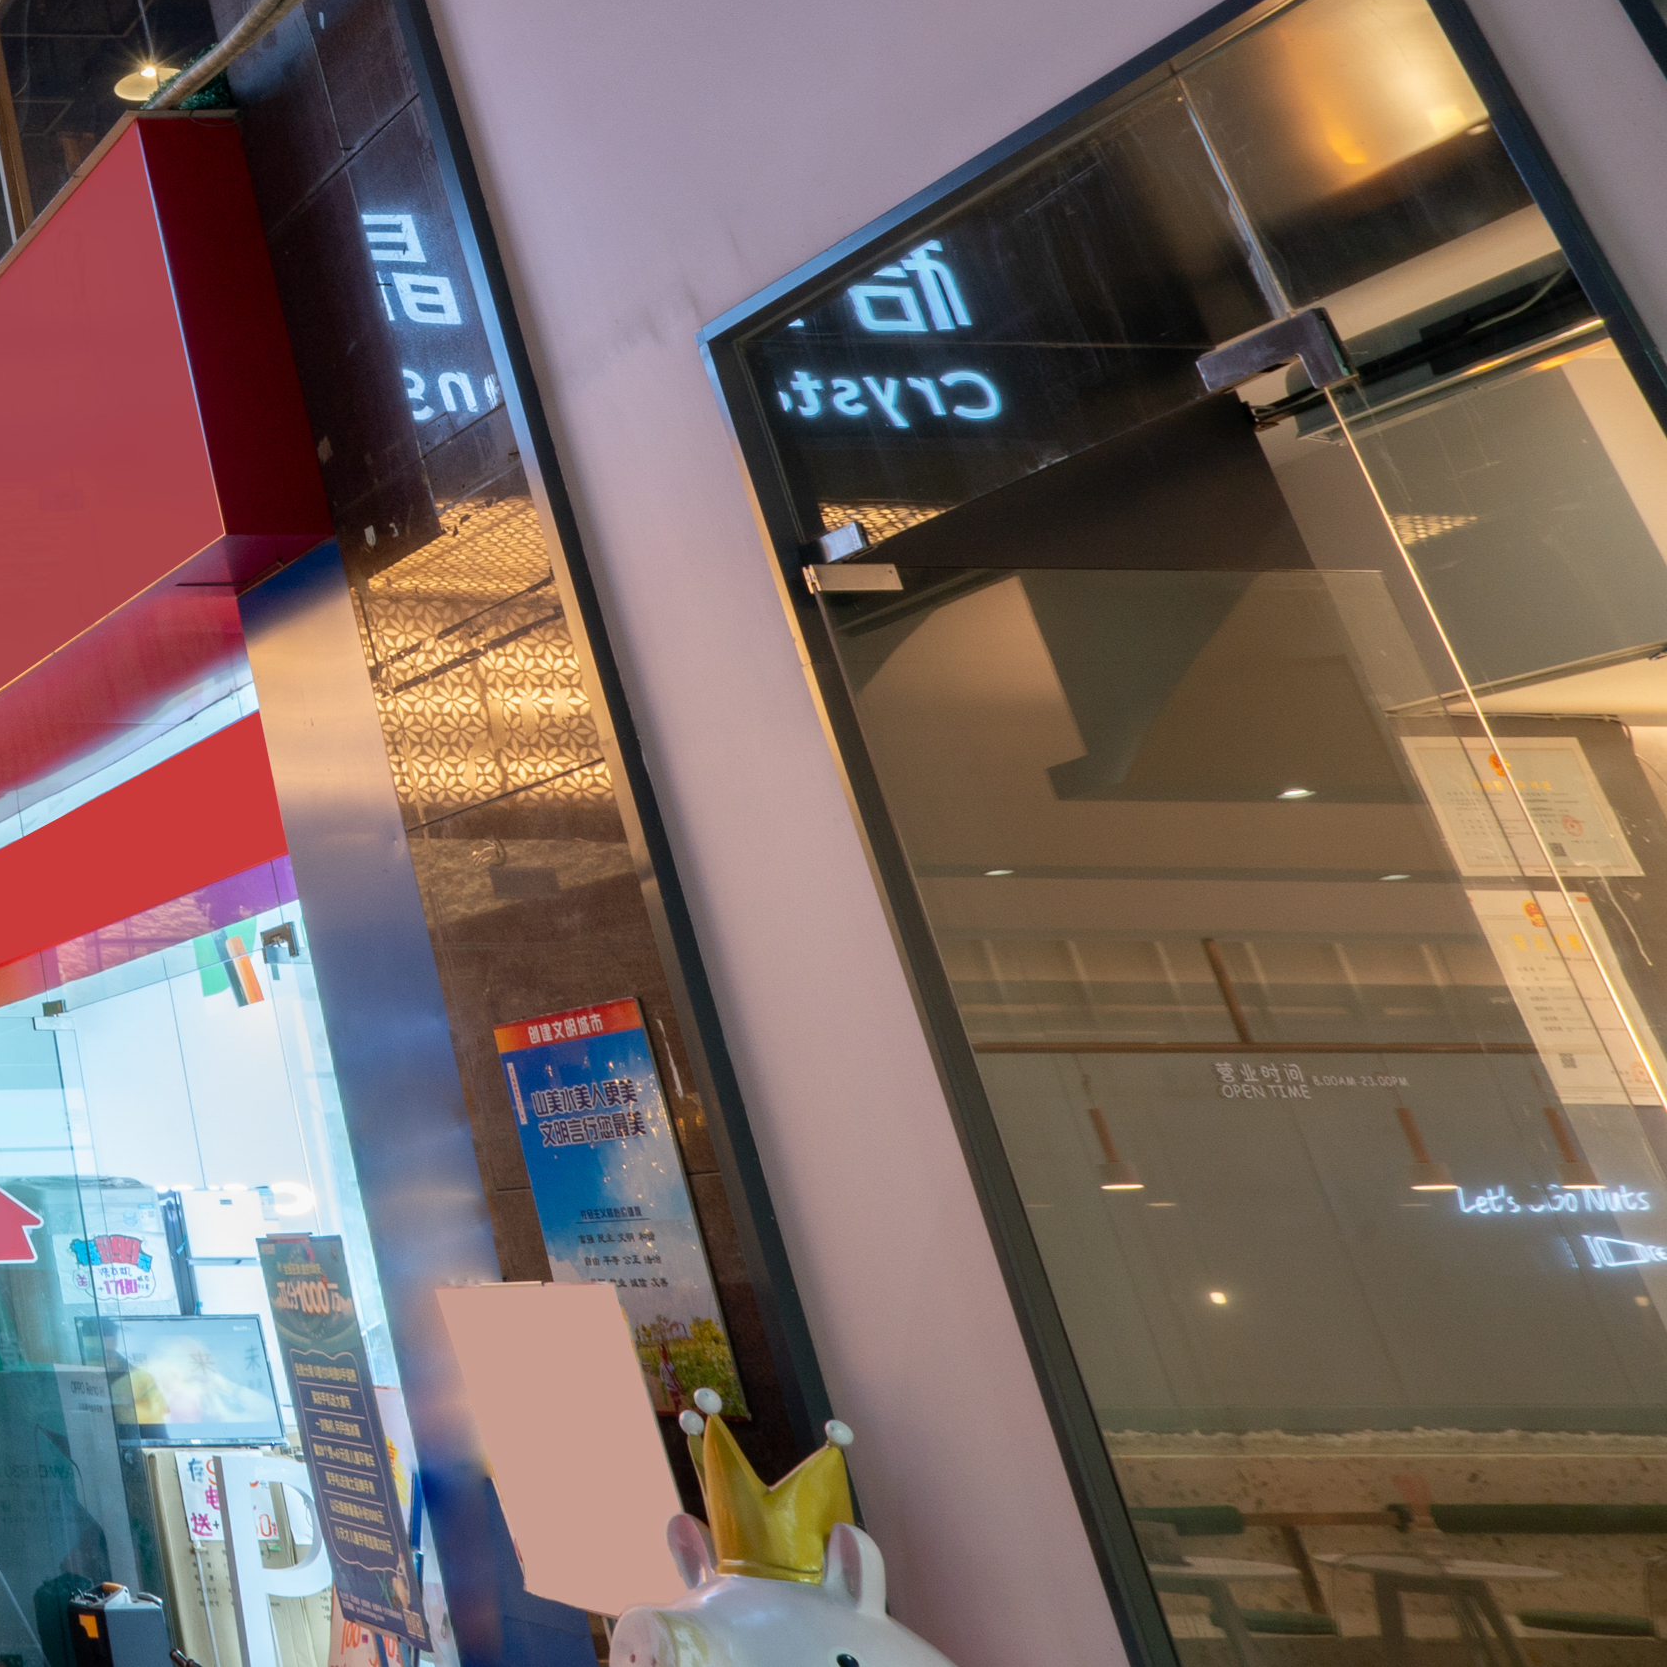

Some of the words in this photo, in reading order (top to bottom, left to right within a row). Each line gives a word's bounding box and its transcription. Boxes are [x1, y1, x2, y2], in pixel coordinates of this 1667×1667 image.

[527, 1013, 604, 1045] 创建文明城市
[1214, 1062, 1305, 1083] 营业时间
[530, 1078, 638, 1118] 山美水美人更美
[1221, 1084, 1266, 1099] OPEN
[1268, 1084, 1312, 1100] TIME
[538, 1111, 647, 1148] 文明言行您最美
[1582, 1184, 1651, 1213] Nuts
